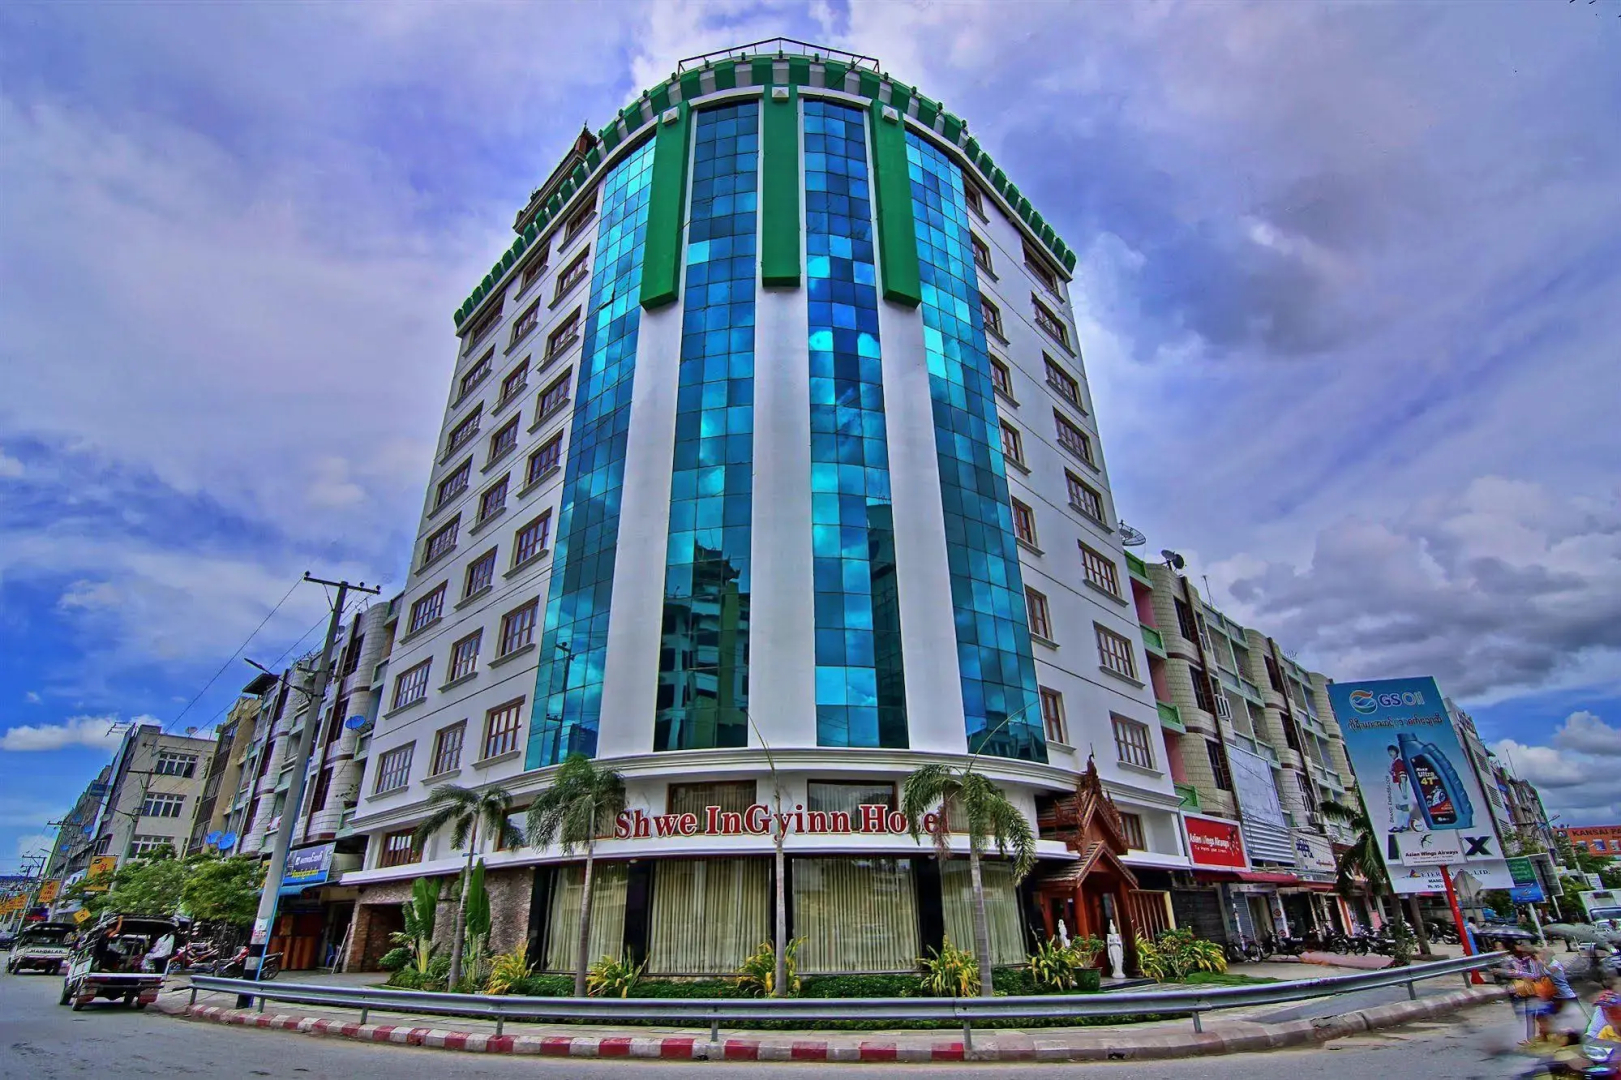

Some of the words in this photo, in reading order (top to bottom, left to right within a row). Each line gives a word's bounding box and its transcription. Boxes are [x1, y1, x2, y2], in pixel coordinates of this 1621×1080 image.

[614, 808, 697, 840] Shwe
[704, 804, 852, 842] InGyinn
[859, 803, 951, 836] Hoel
